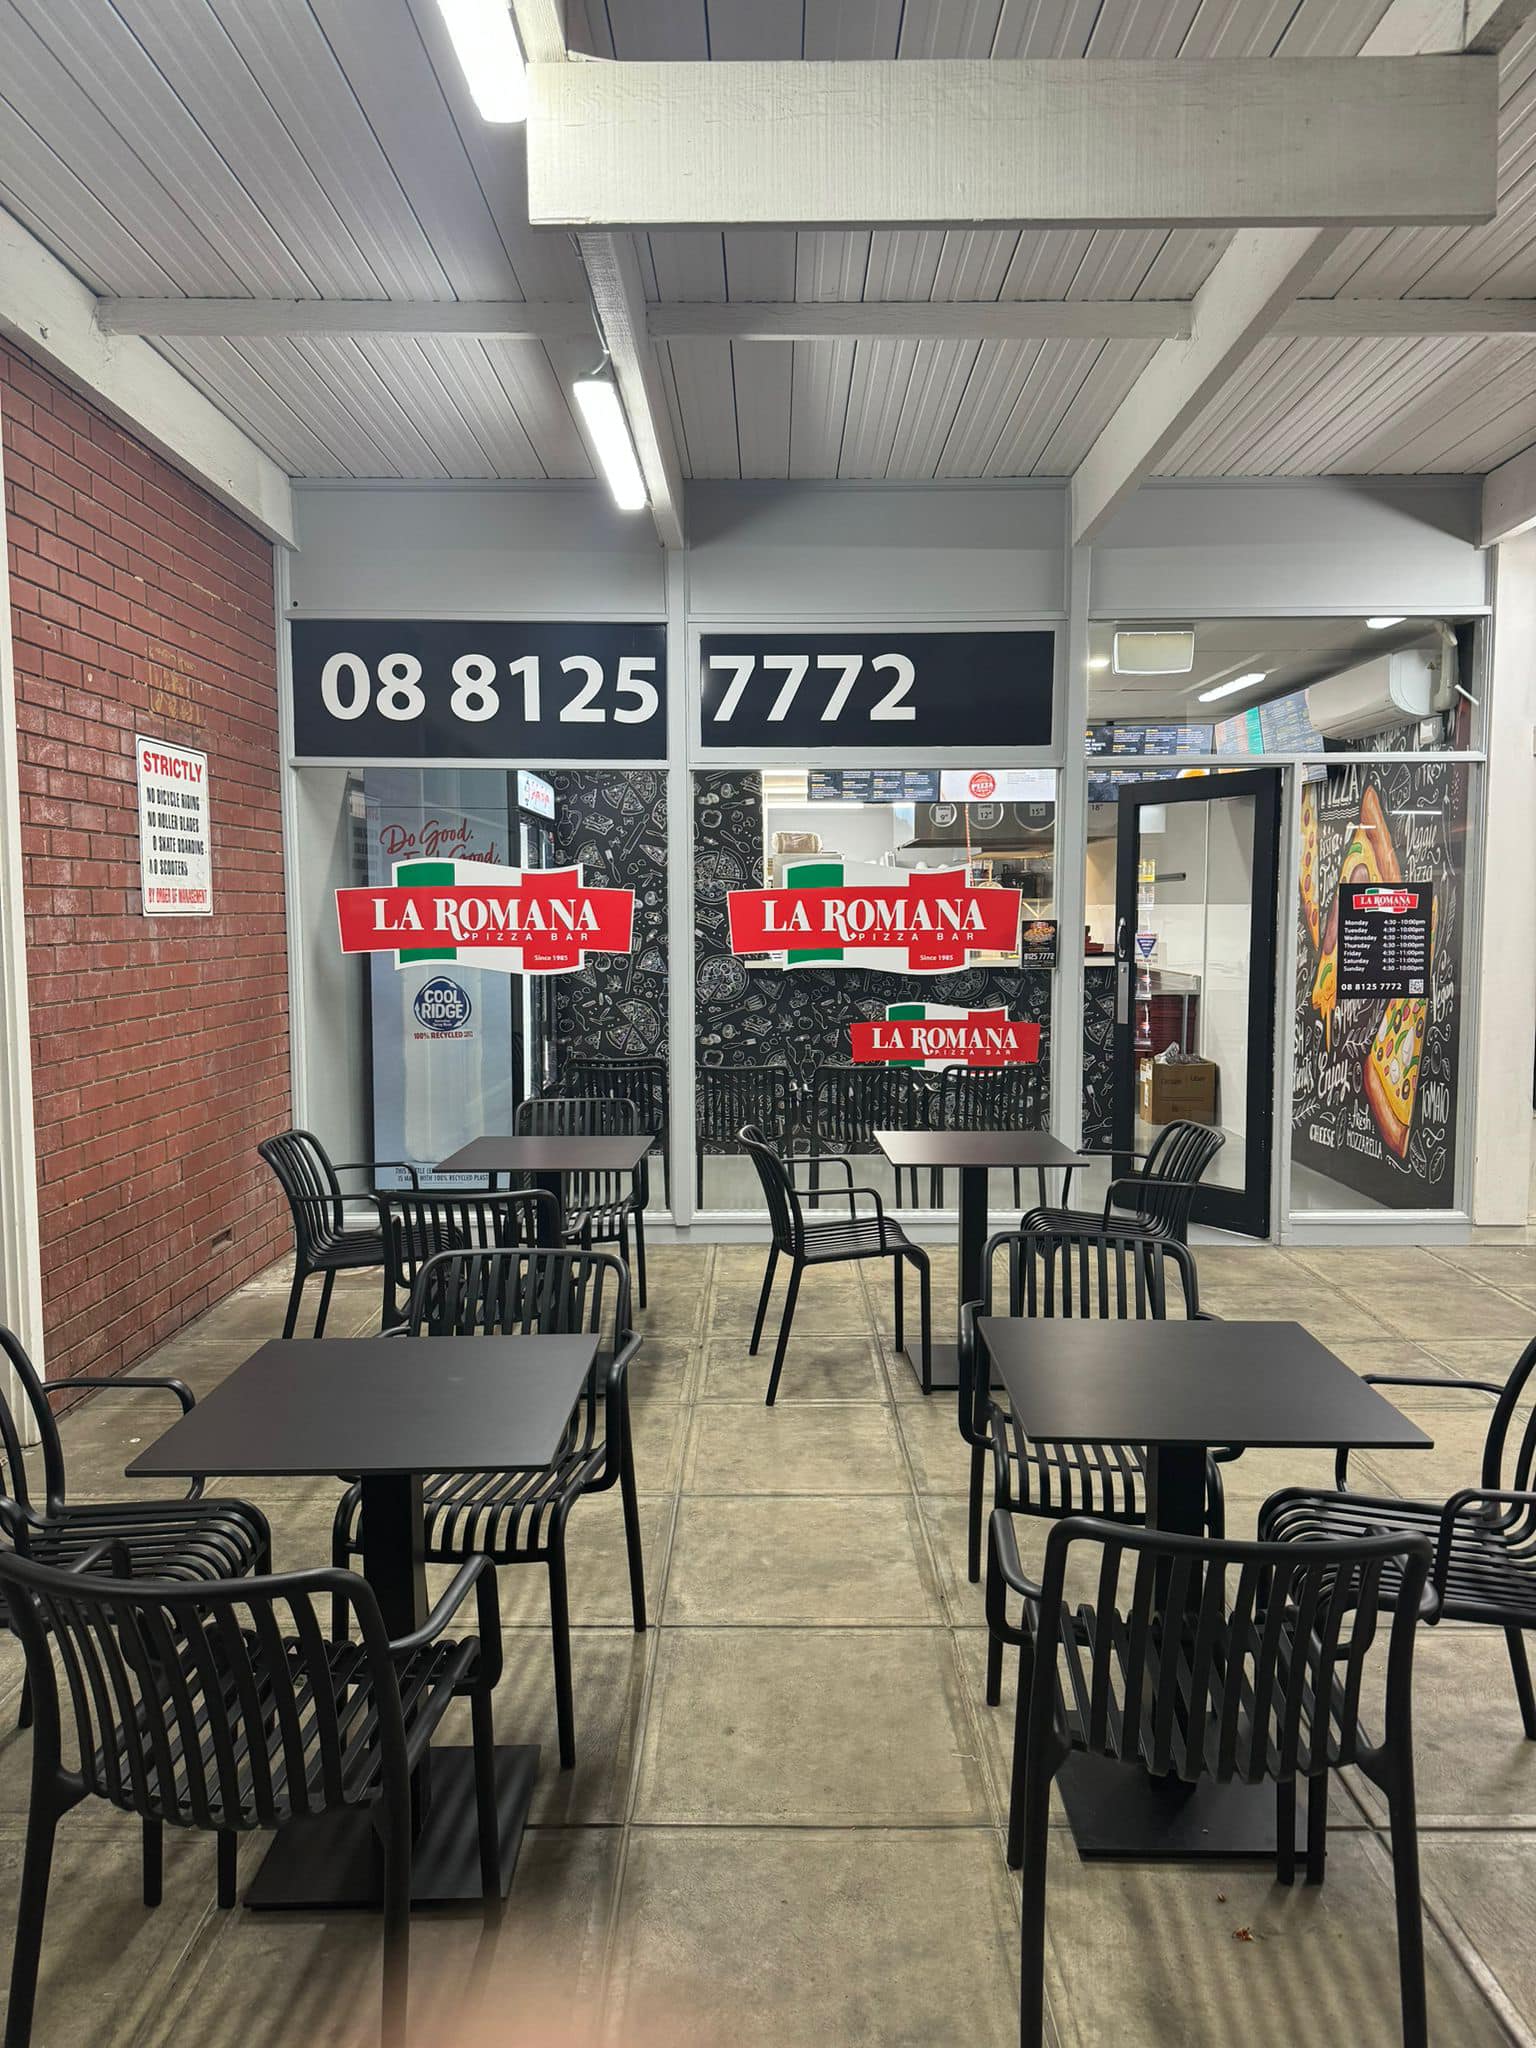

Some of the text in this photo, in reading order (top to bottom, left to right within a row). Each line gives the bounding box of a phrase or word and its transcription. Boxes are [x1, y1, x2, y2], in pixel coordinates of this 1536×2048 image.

[321, 652, 916, 724] 08 8125 7772
[143, 751, 202, 783] STRICTLY
[147, 787, 200, 812] NO BICYCLE RIDING
[148, 811, 199, 833] NO ROLLER BLADES
[159, 836, 176, 853] SKATE
[177, 838, 204, 855] BOARDING
[380, 817, 474, 857] Do Good.
[160, 859, 188, 877] SCOOTERS
[1360, 896, 1411, 906] LA ROMANA
[372, 898, 601, 941] LA ROMANA
[762, 898, 987, 941] LA ROMANA
[472, 932, 588, 941] PIZZA BAR
[859, 932, 974, 941] PIZZA BAR
[1039, 952, 1055, 960] 7772
[424, 989, 461, 1004] COOL
[1341, 982, 1402, 991] 08 8125 7772
[421, 1003, 463, 1019] RIDGE
[431, 1031, 463, 1039] RECYCLED
[872, 1027, 1018, 1055] LA ROMANA
[1318, 1051, 1350, 1106] Enjoy
[1420, 1081, 1450, 1124] TOMATO
[1310, 1123, 1335, 1148] CHEESE
[1346, 1129, 1383, 1160] MOZZARELLA
